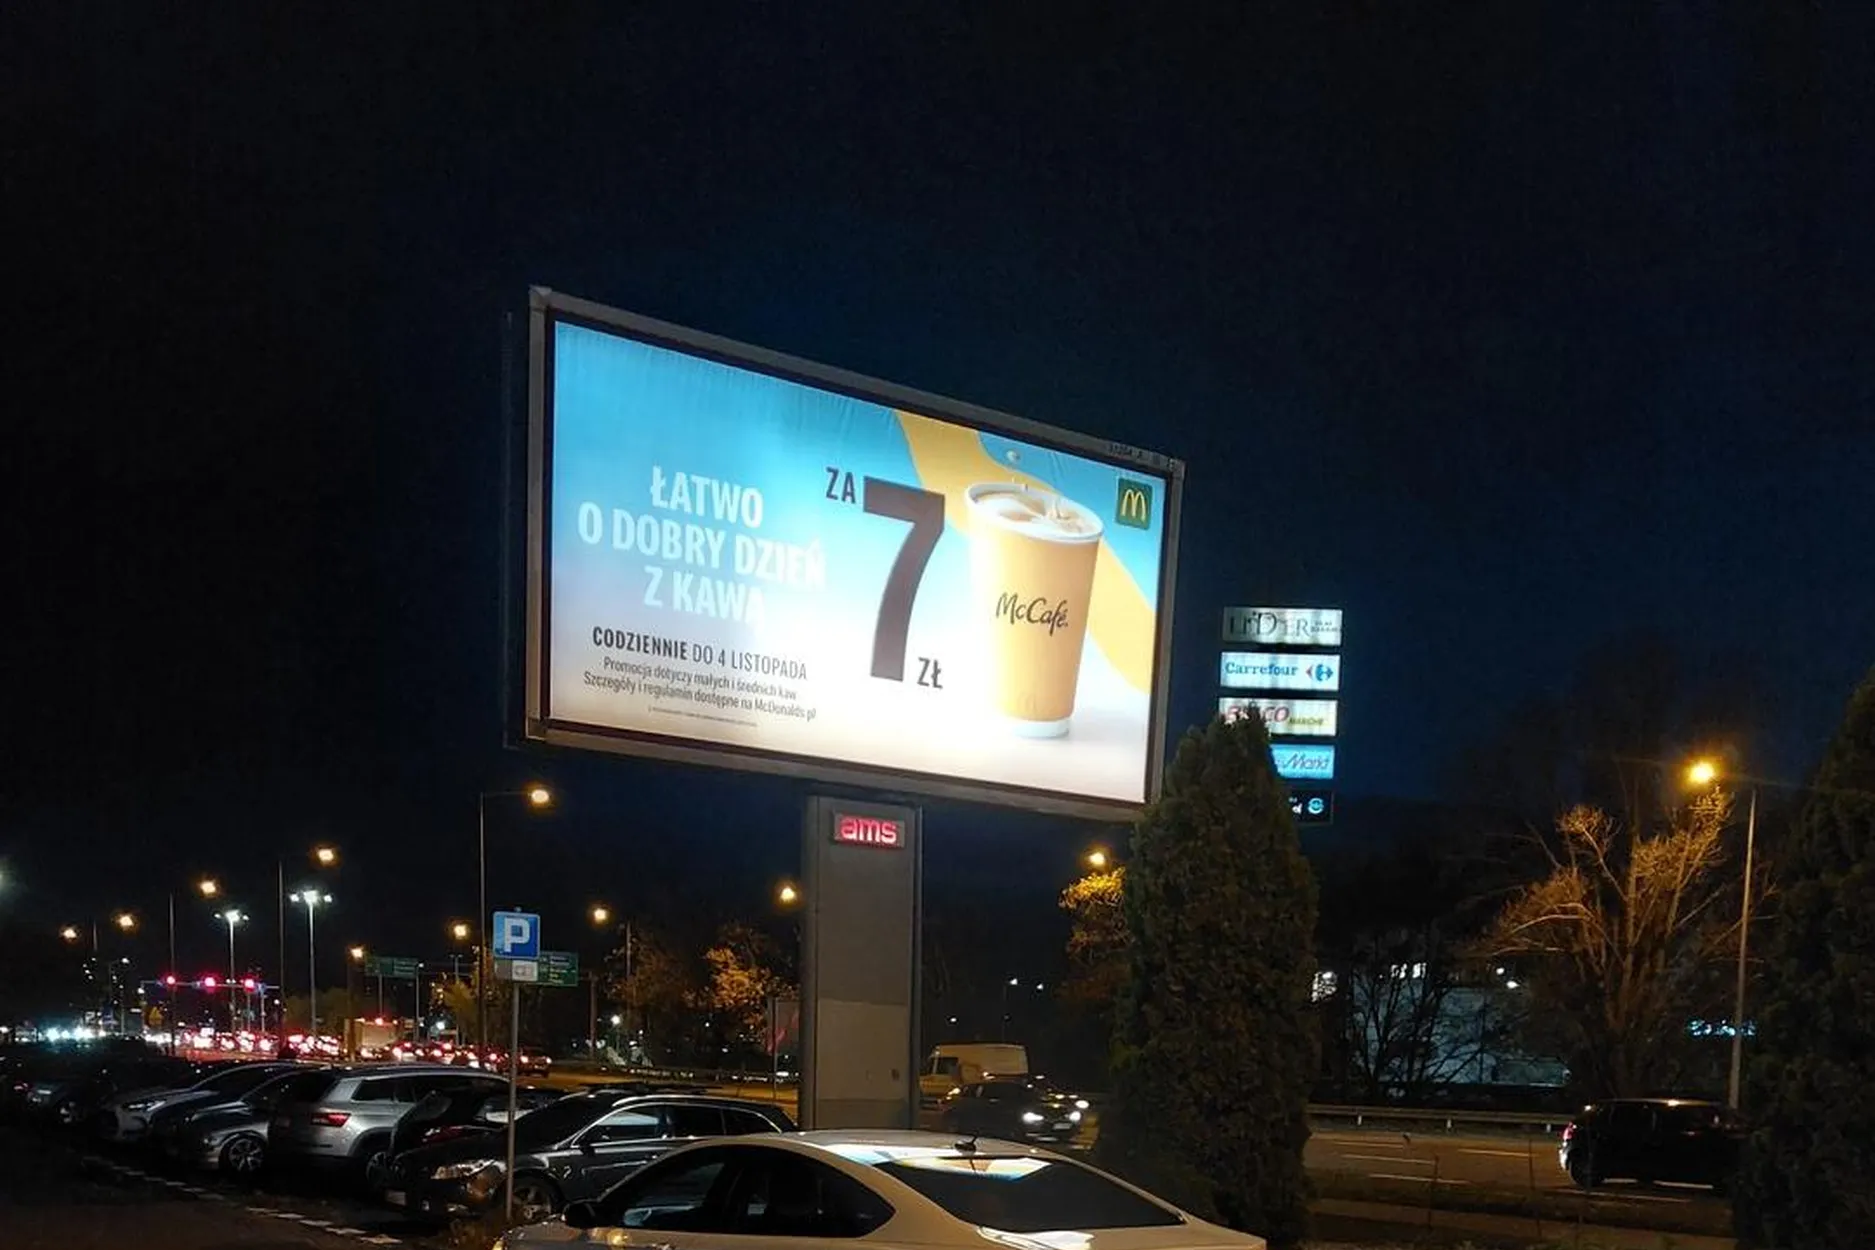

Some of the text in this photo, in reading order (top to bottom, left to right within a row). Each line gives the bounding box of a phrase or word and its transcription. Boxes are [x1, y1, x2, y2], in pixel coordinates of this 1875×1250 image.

[650, 465, 763, 528] ŁATWO
[825, 466, 856, 504] ZA
[578, 502, 603, 545] O
[612, 508, 725, 569] DOBRY
[643, 566, 663, 607] Z
[863, 475, 945, 682] 7
[995, 592, 1069, 636] McCafé
[592, 626, 808, 680] CODZIENNIE DO 4 LISTOPADA
[603, 656, 652, 680] Promocja
[1224, 661, 1299, 676] Carrefour
[583, 671, 636, 695] Szczegóły
[917, 656, 943, 690] ZŁ
[841, 817, 898, 845] ams
[504, 918, 530, 952] P
